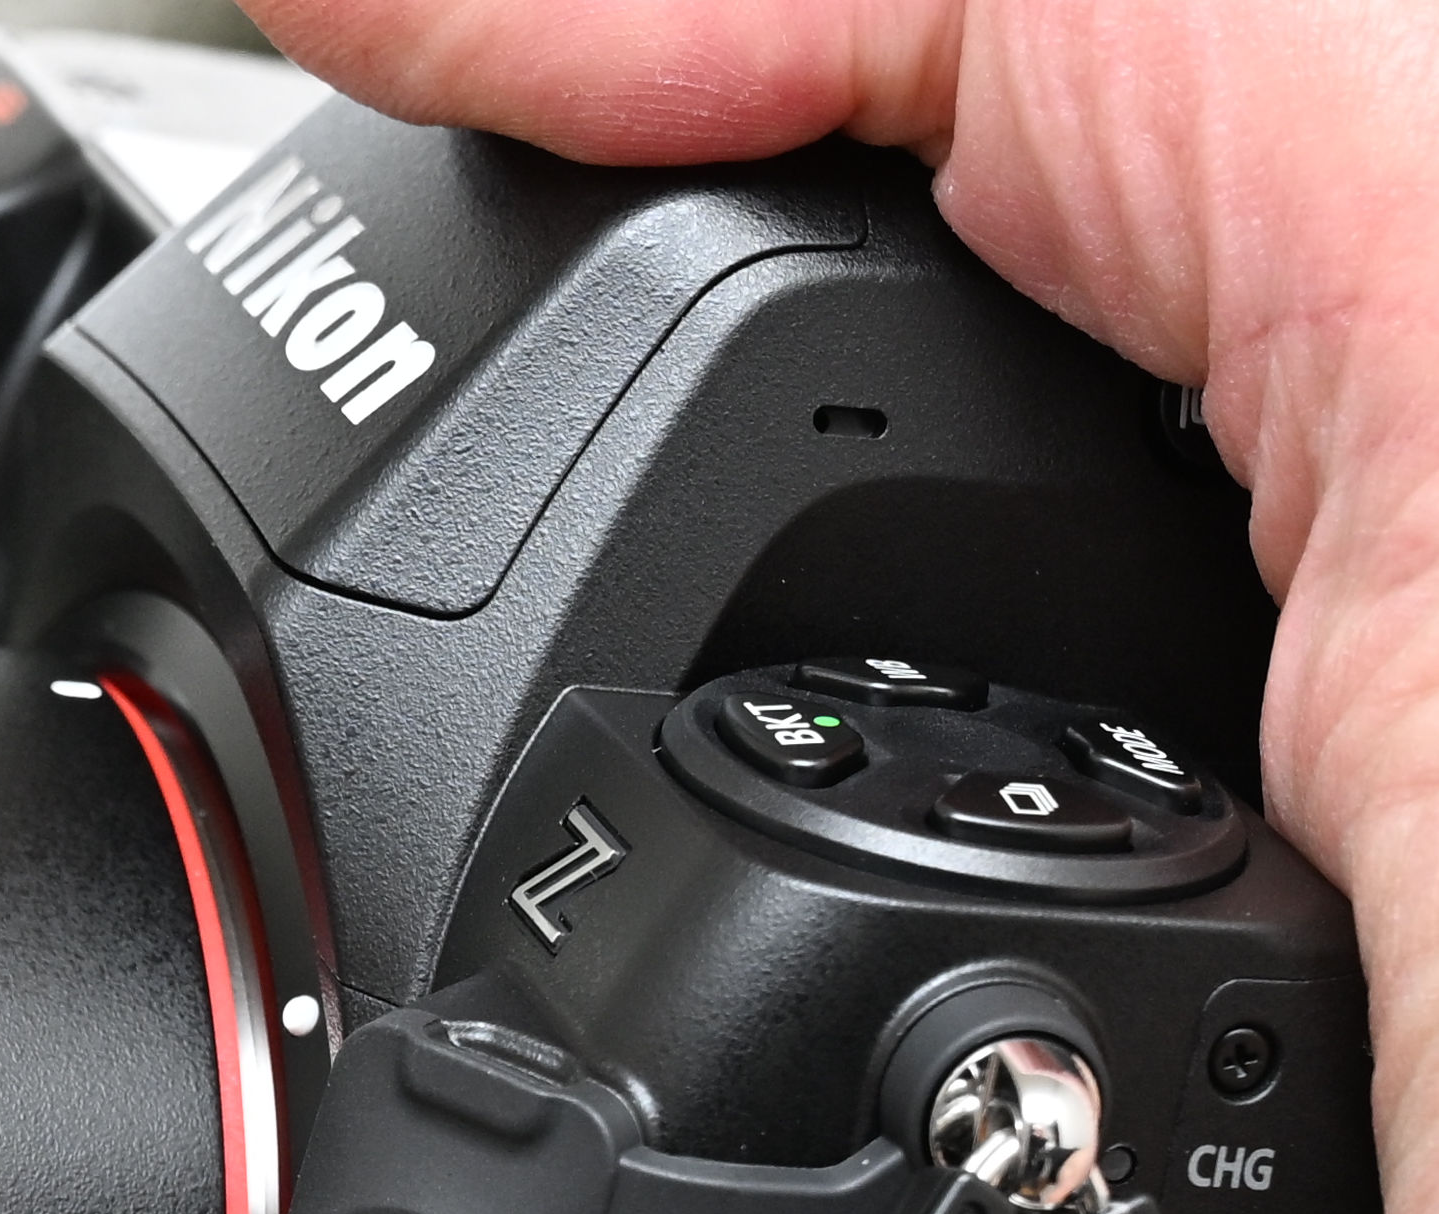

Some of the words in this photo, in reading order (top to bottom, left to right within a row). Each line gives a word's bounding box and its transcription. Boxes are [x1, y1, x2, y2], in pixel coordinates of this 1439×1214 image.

[186, 155, 436, 425] Nikon
[865, 658, 928, 680] WB
[743, 701, 826, 746] BKT
[1099, 722, 1185, 776] MODE
[510, 800, 626, 946] Z
[1187, 1144, 1276, 1191] CHG
